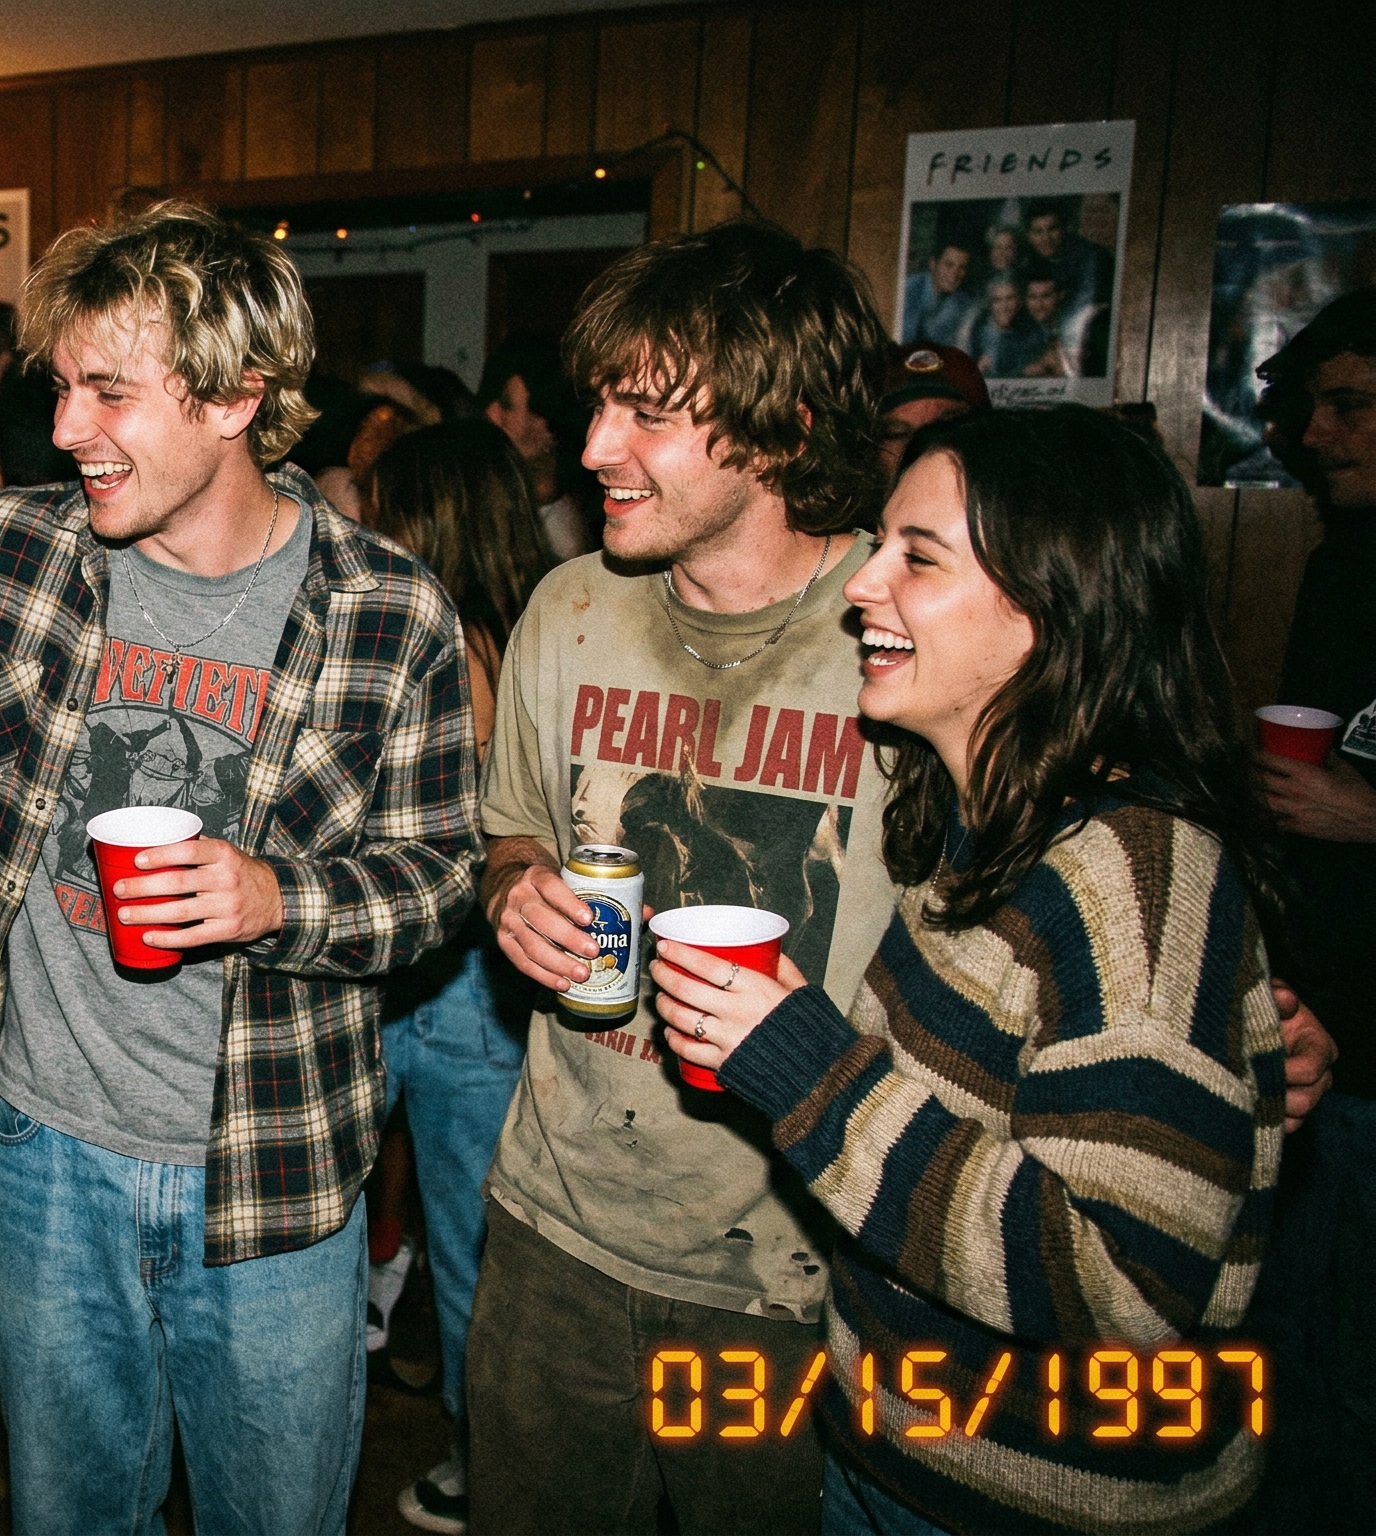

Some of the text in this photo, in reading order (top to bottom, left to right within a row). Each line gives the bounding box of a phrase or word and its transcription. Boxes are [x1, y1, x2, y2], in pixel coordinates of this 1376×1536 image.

[926, 147, 1112, 186] FRIENDS
[571, 684, 867, 799] PEARL JAM
